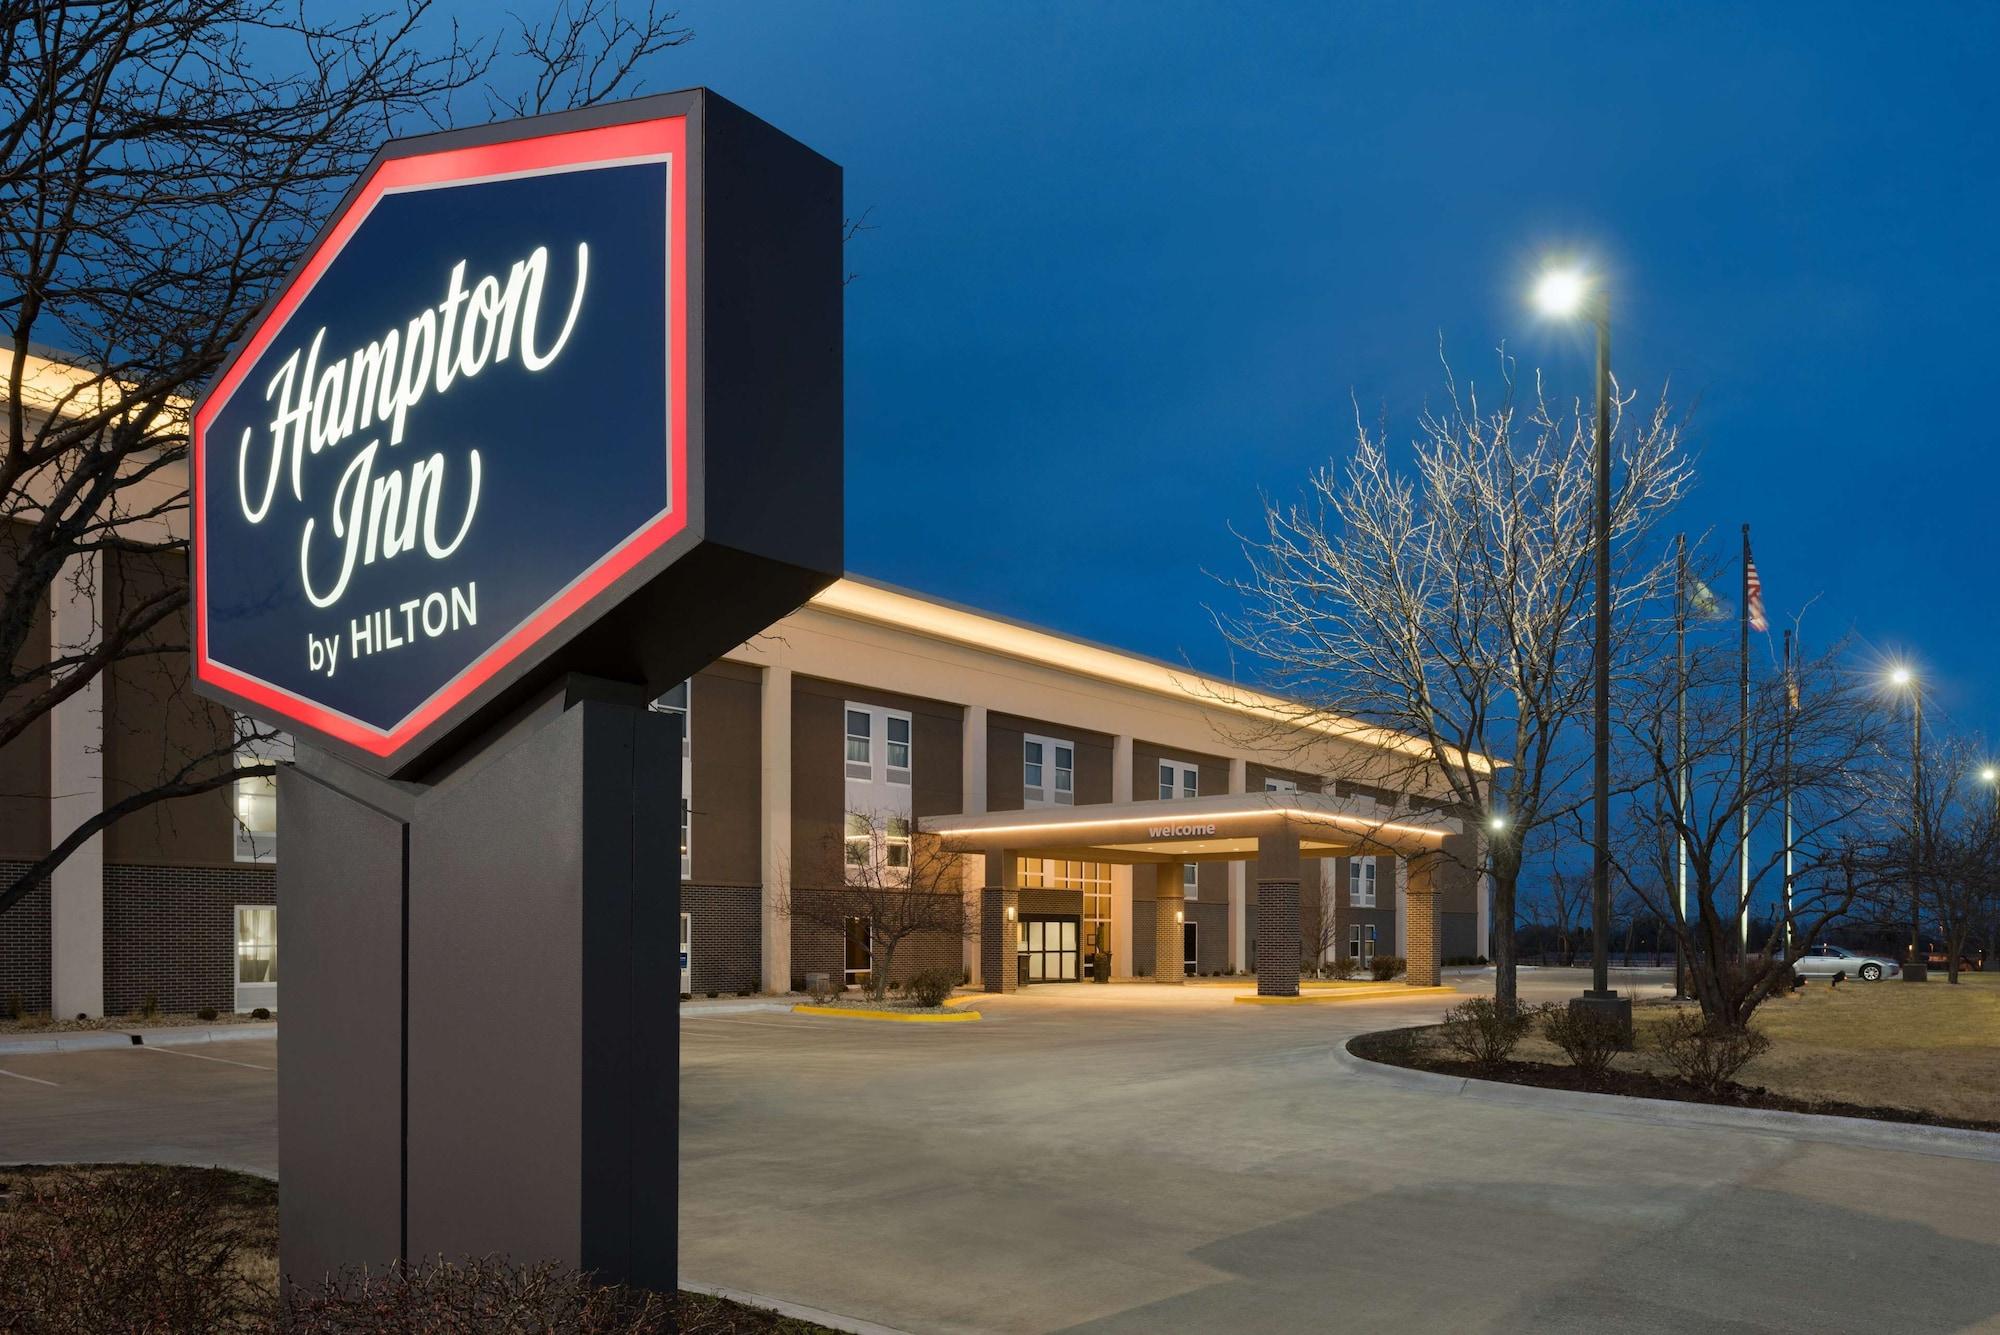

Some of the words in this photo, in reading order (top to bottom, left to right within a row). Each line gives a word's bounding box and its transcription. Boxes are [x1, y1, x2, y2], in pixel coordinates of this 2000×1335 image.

[238, 241, 589, 524] Hampton
[300, 438, 482, 609] Inn
[307, 632, 341, 678] by
[350, 581, 478, 659] HILTON
[1149, 823, 1216, 837] welcome
